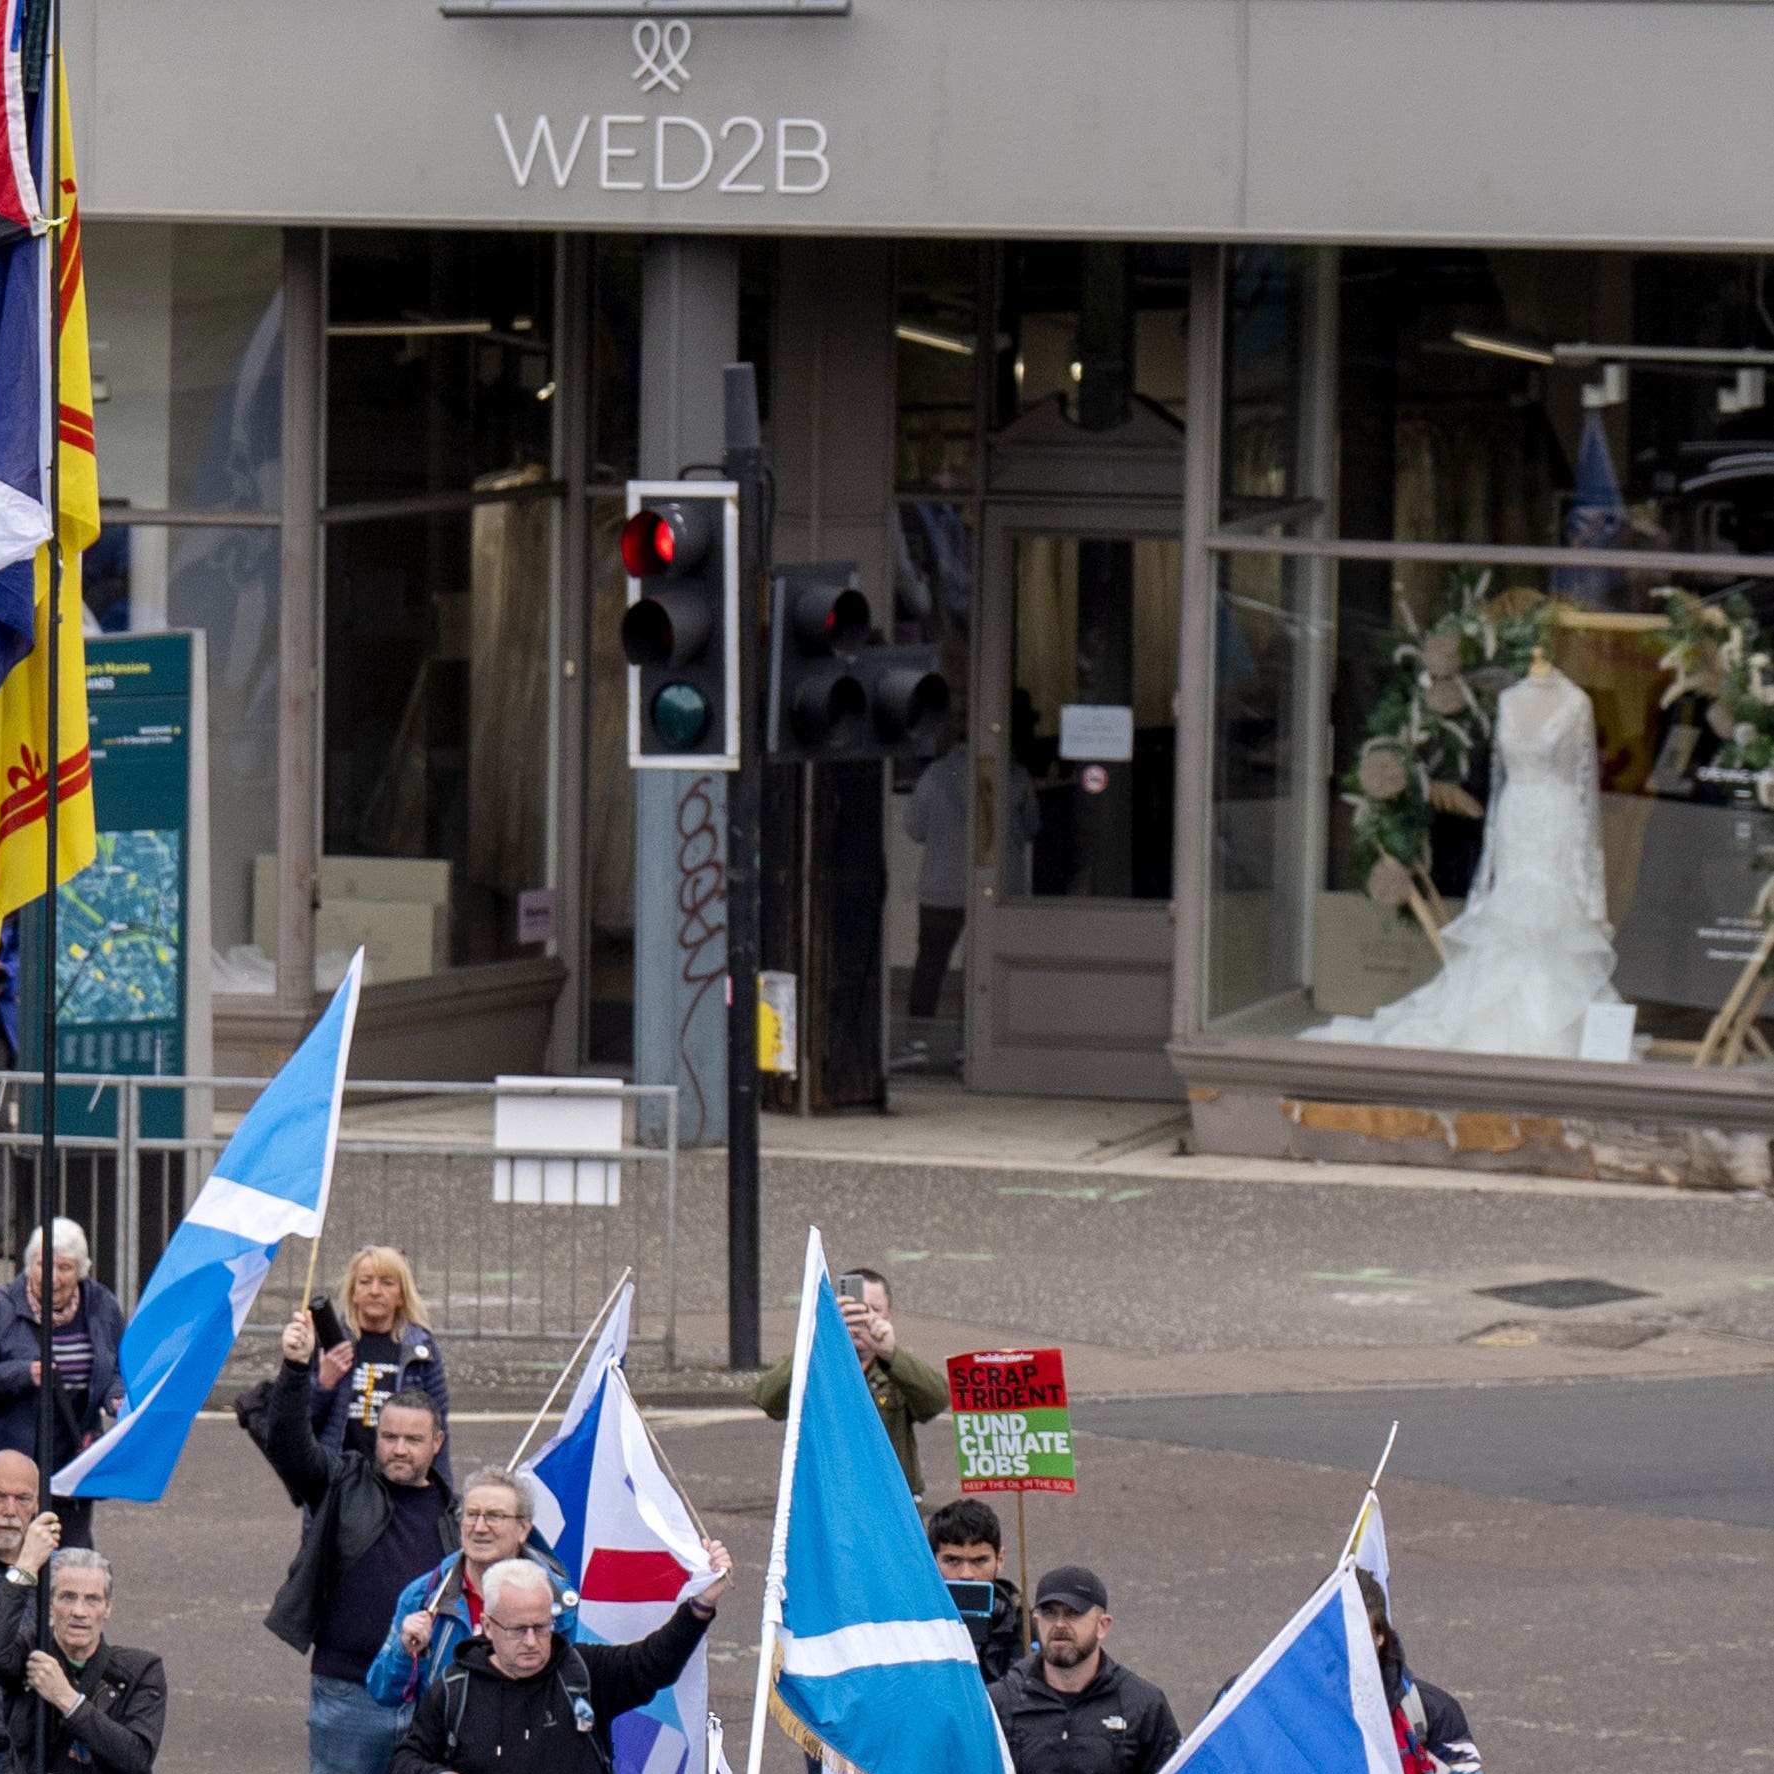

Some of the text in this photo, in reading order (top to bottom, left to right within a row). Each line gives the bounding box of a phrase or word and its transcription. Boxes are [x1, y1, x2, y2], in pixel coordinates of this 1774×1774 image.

[495, 114, 831, 195] WED2B
[953, 1364, 1038, 1387] SCRAP
[955, 1384, 1061, 1408] TRIDENT
[957, 1413, 1027, 1436] FUND
[960, 1431, 1070, 1456] CLIMATE
[963, 1455, 1030, 1477] JOBS
